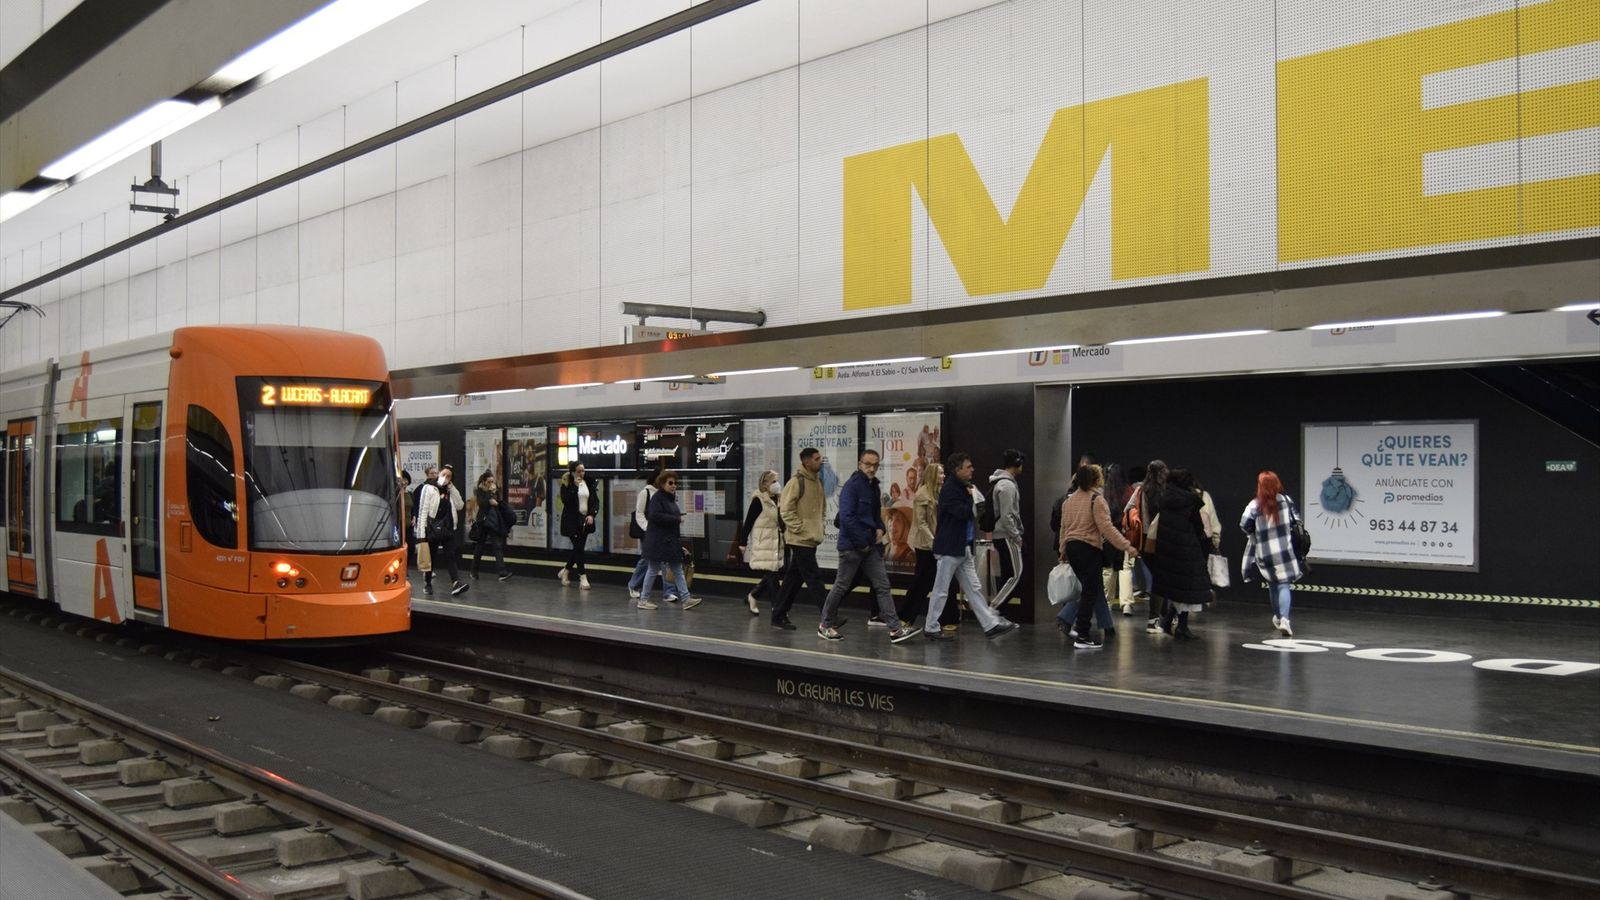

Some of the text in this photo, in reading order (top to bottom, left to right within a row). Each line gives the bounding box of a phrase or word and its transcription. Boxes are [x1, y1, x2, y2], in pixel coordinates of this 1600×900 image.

[1072, 346, 1110, 357] Mercado
[882, 368, 896, 376] Sabio
[901, 366, 908, 375] C/
[908, 366, 919, 374] San
[920, 365, 939, 373] Vicente
[262, 385, 276, 405] 2
[281, 386, 323, 402] LUCEROS
[330, 388, 370, 404] ALACANT
[810, 424, 847, 436] ¿QUIERES
[871, 427, 904, 438] Mi otro
[578, 434, 628, 455] Mercado
[798, 437, 852, 448] QUE TE VEAN?
[1377, 435, 1452, 452] ¿QUIERES
[1361, 453, 1468, 467] QUE TE VEAN?
[1375, 476, 1454, 488] ANÚNCIATE CON
[1397, 493, 1444, 502] promedios
[1369, 519, 1458, 533] 963 44 87 34
[777, 678, 894, 712] NO CREUAR LES VIES
